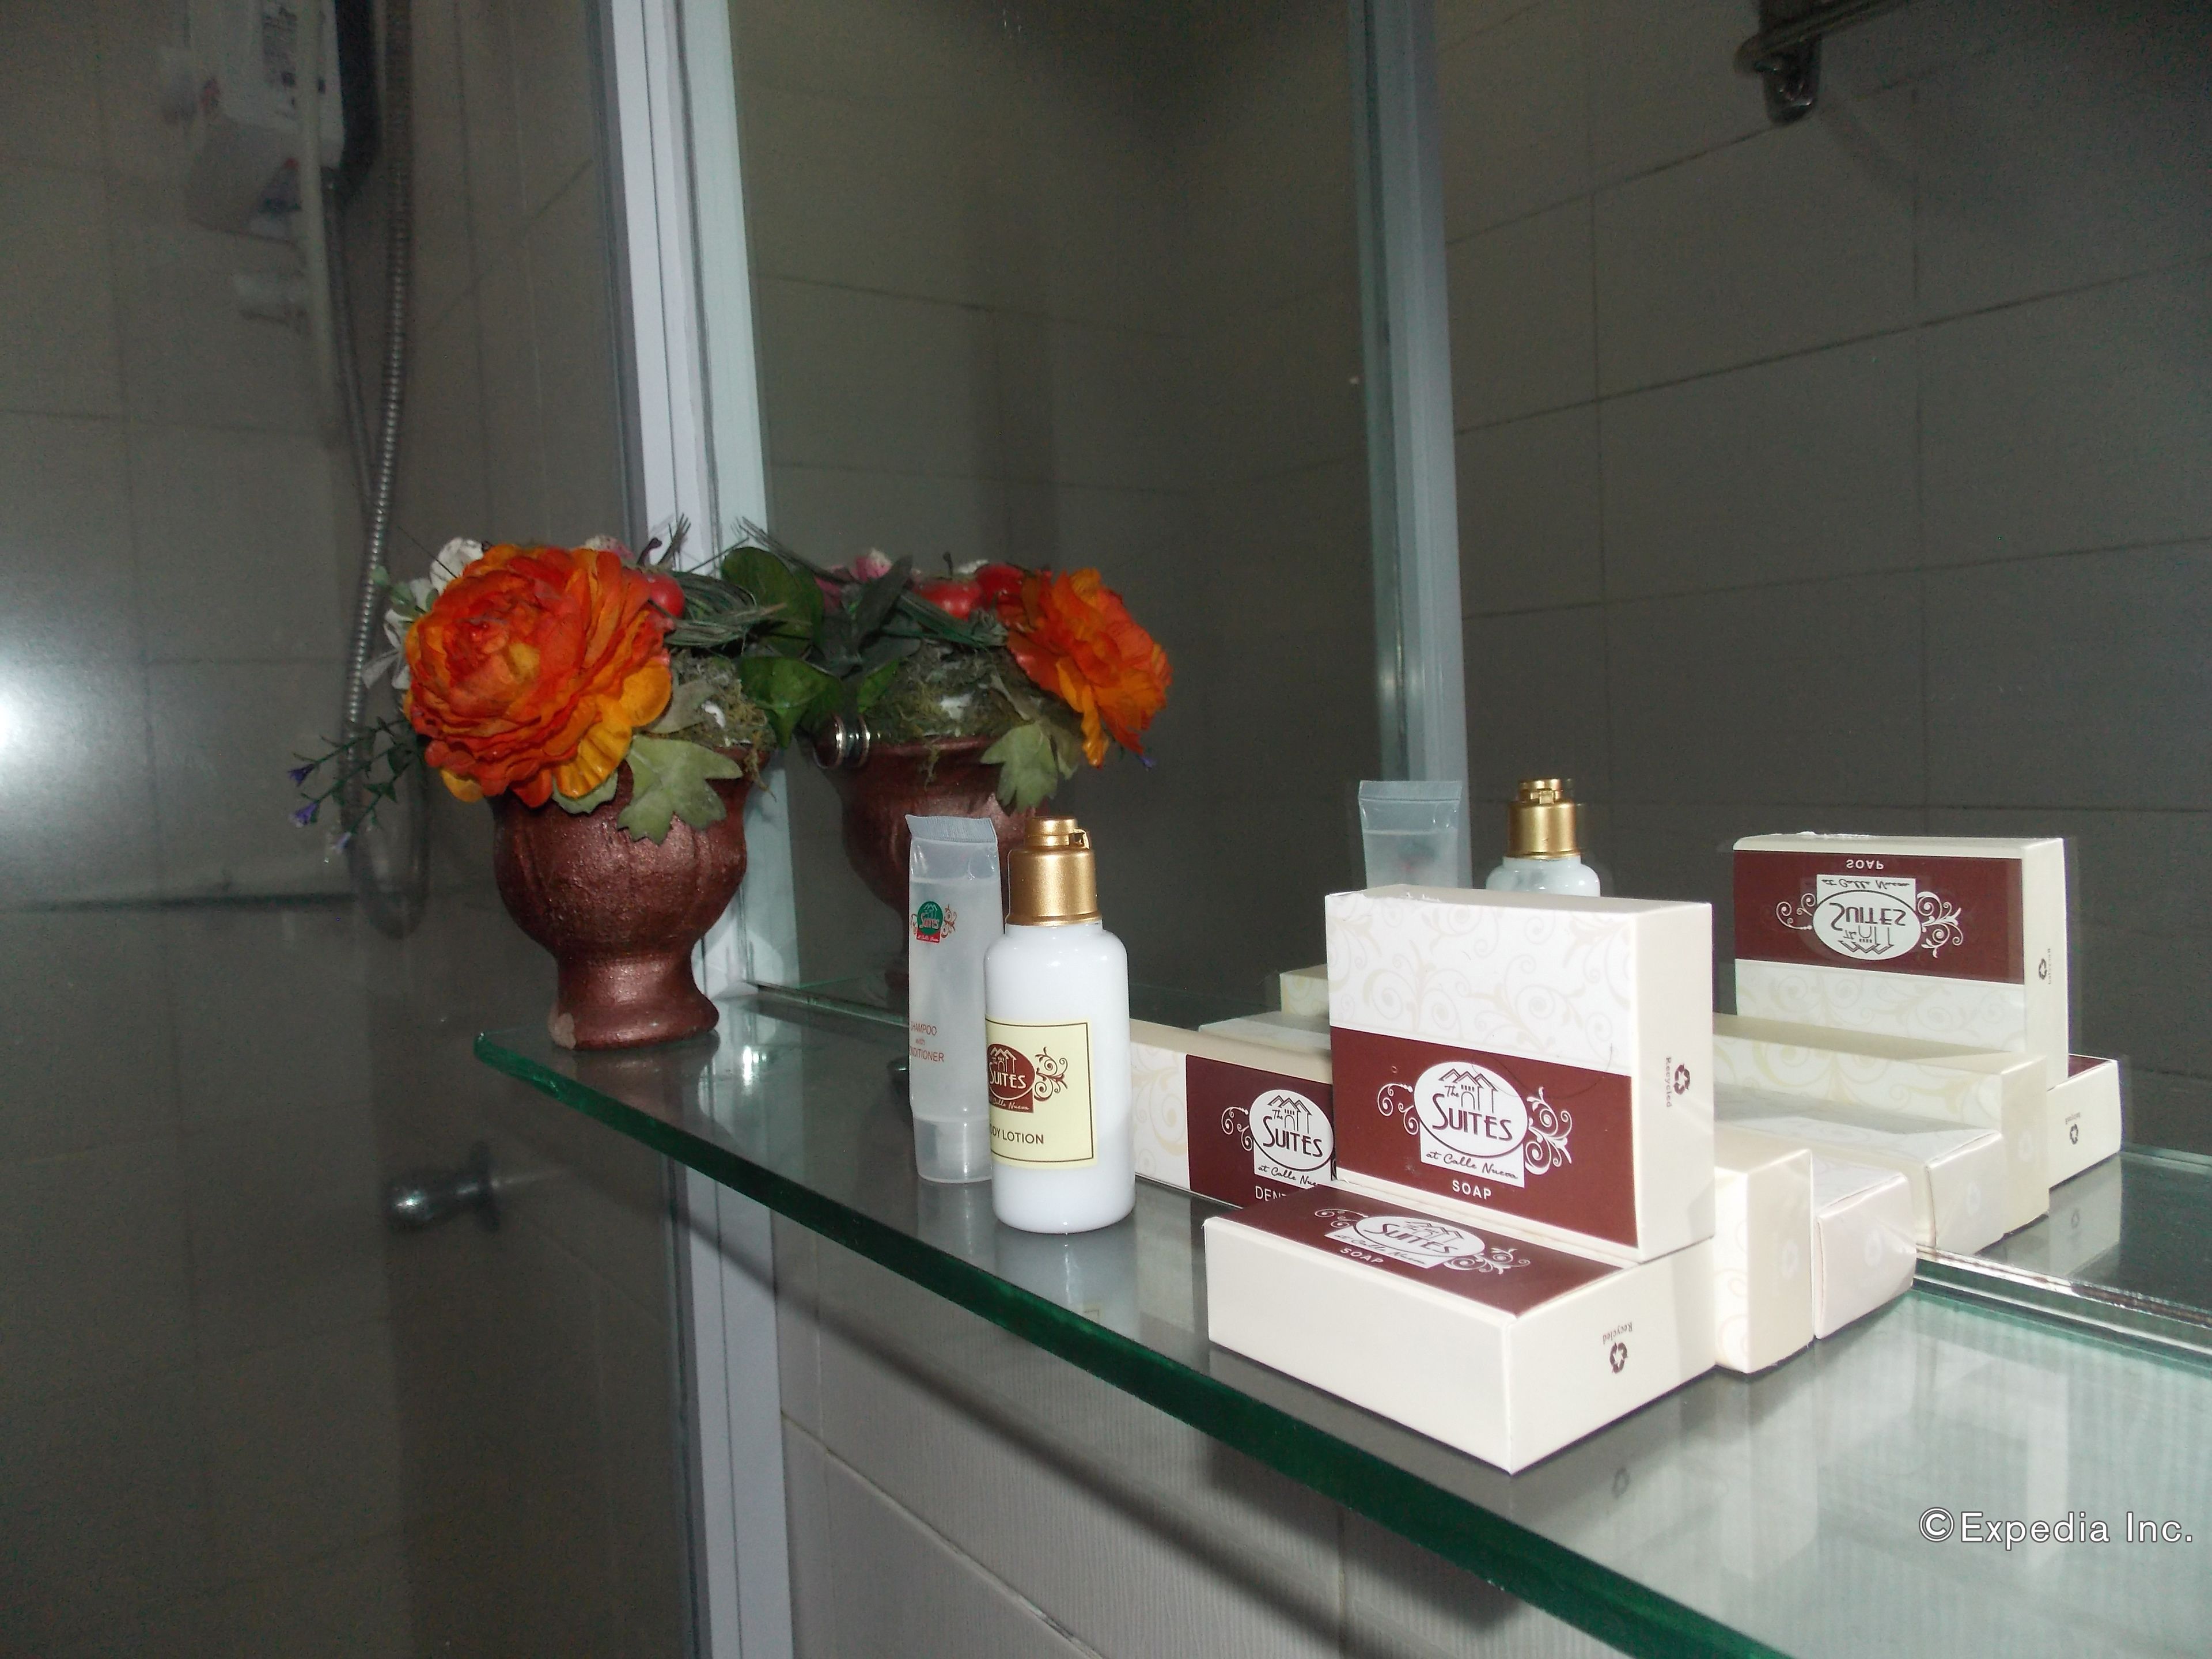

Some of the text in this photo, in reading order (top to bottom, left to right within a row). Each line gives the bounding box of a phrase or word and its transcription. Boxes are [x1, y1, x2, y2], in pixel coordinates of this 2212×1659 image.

[988, 1062, 1027, 1089] SUITES
[1444, 1085, 1460, 1097] The
[1272, 1109, 1284, 1120] The
[1431, 1093, 1513, 1142] SUITES
[1002, 1130, 1044, 1145] LOTION
[1262, 1115, 1324, 1158] SUITES
[1271, 1166, 1297, 1180] Calle
[1300, 1175, 1319, 1187] Nue
[1425, 1152, 1519, 1180] at Calle Nueva
[1255, 1185, 1287, 1202] DEN
[1452, 1179, 1492, 1200] SOAP
[1363, 1223, 1459, 1254] SUITES
[1340, 1248, 1384, 1264] SOAP
[1603, 1321, 1633, 1345] Recycled
